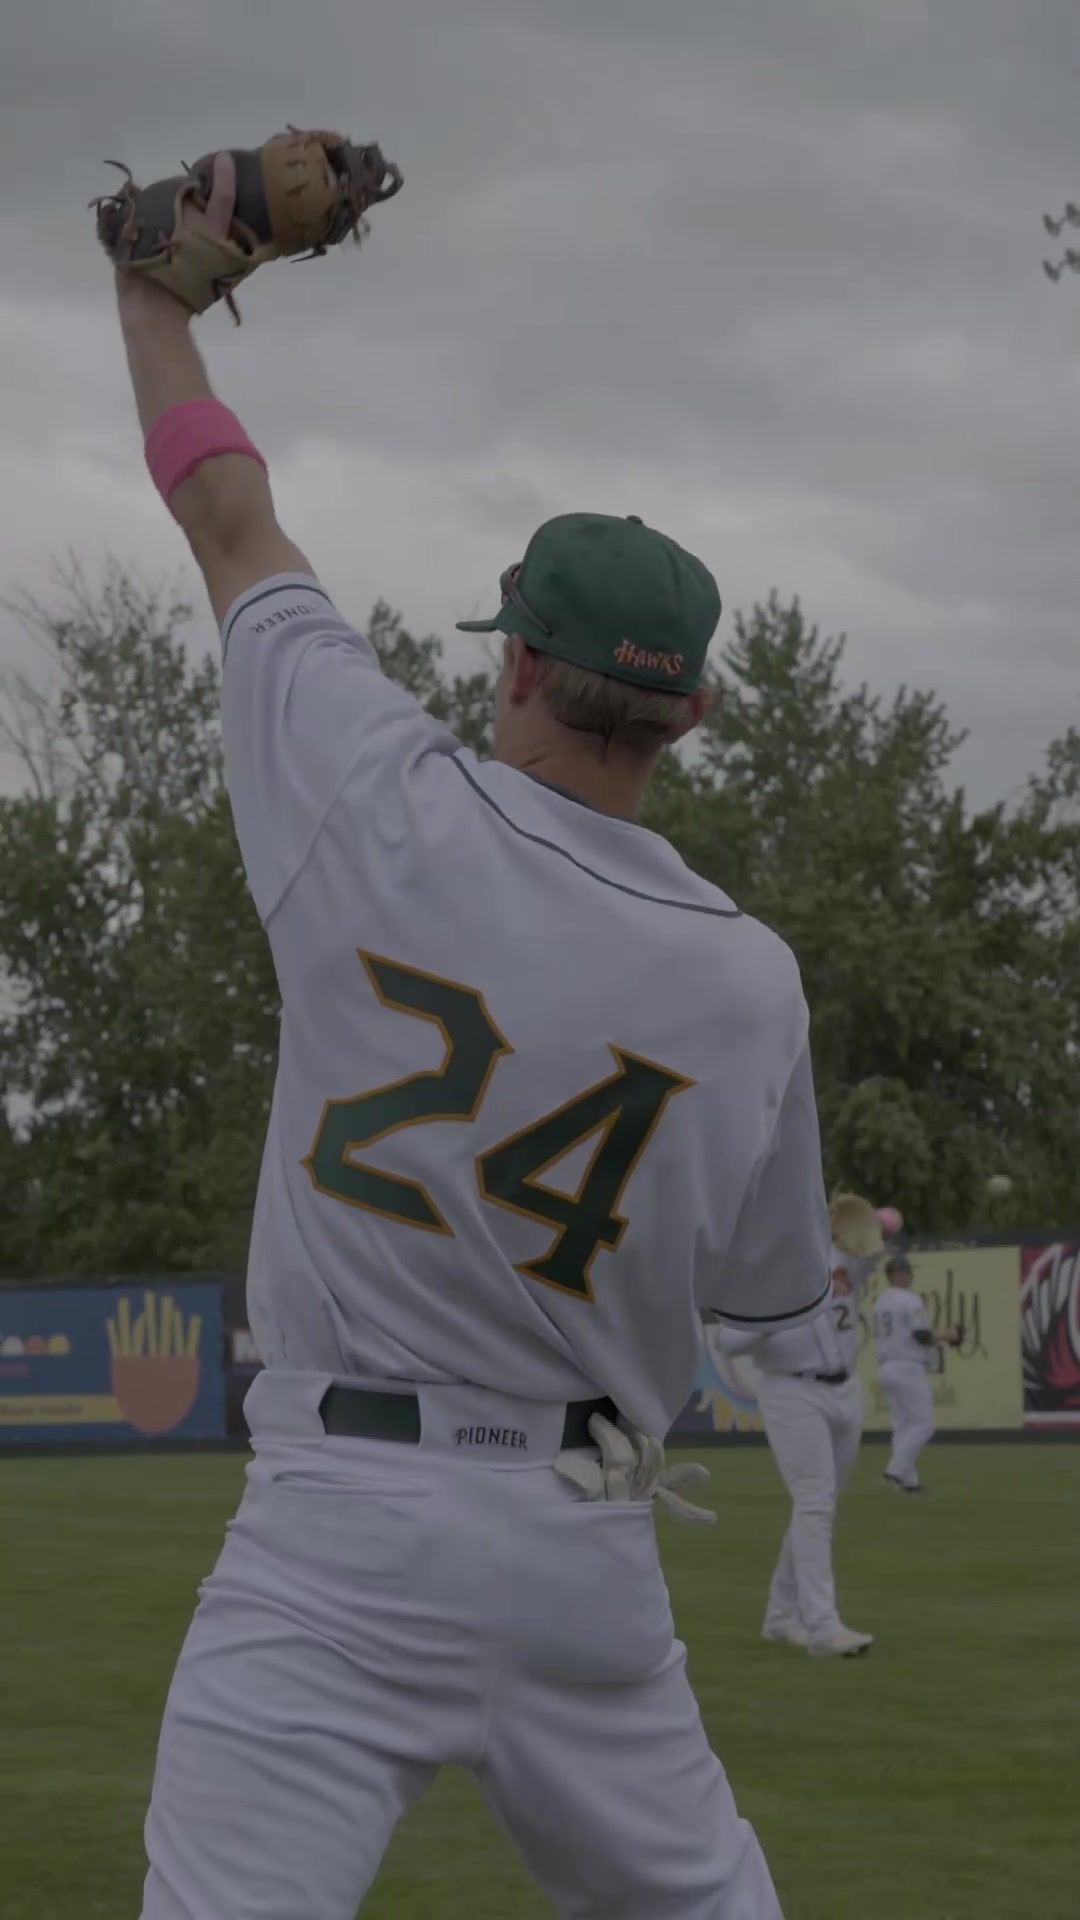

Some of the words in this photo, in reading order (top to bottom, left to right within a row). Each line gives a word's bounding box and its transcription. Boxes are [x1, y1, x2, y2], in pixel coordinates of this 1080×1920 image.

[249, 605, 314, 634] ONEER
[613, 639, 684, 676] HAWKS
[300, 948, 698, 1303] 24
[455, 1426, 528, 1451] PIONEER
